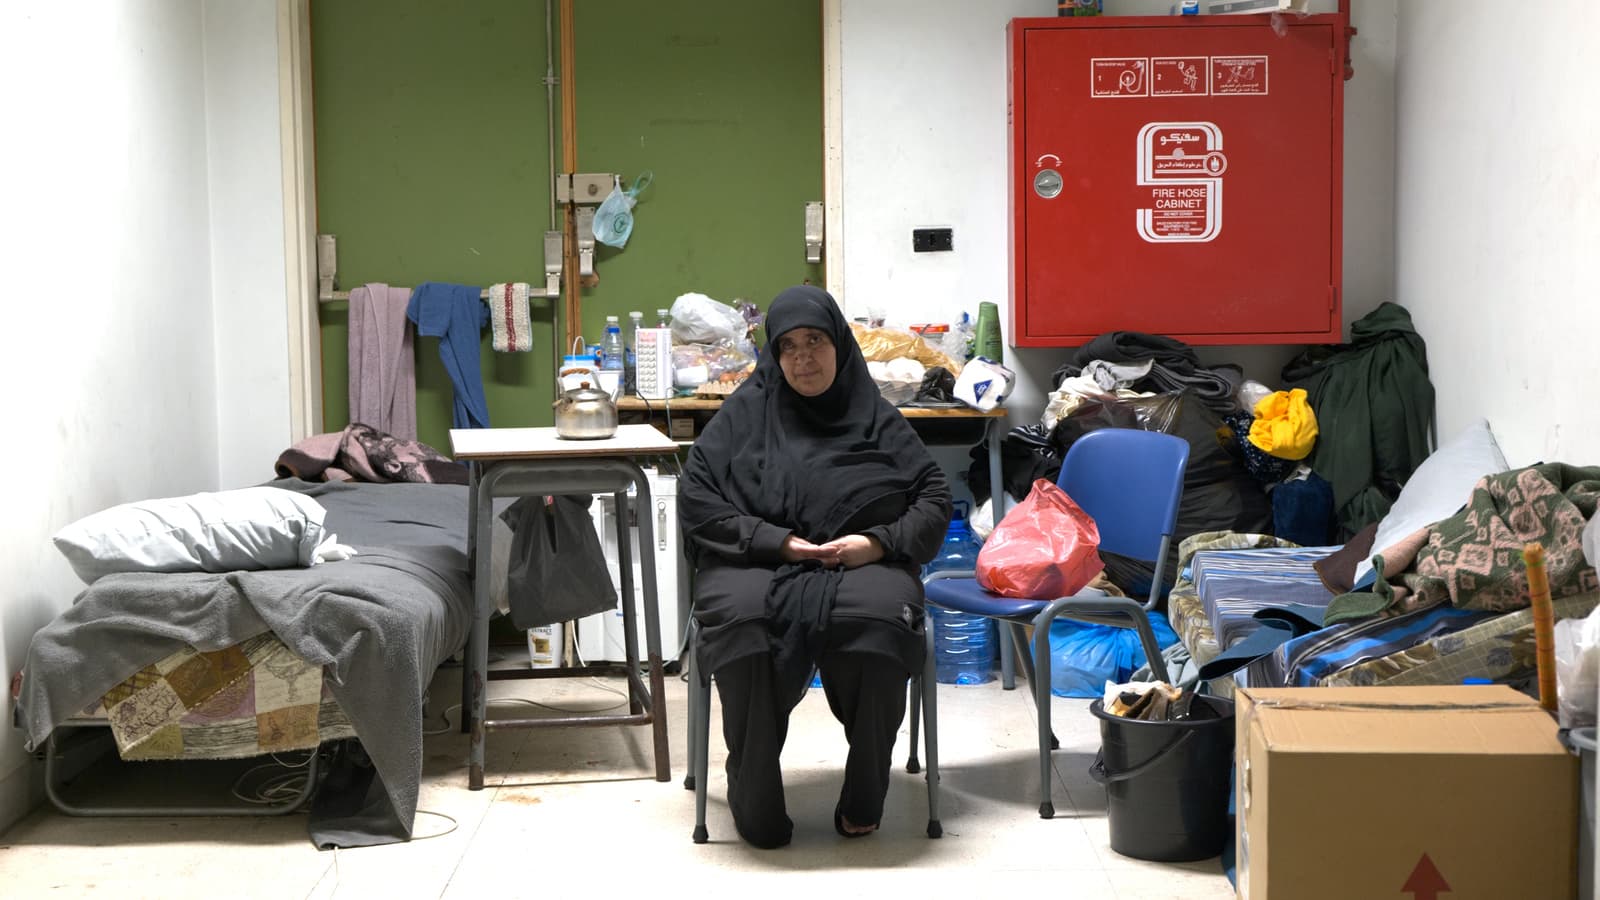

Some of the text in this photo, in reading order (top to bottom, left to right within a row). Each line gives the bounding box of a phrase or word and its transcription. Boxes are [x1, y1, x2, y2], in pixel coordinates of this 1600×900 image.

[1152, 188, 1206, 198] FIRE HOSE
[1156, 199, 1202, 209] CABINET
